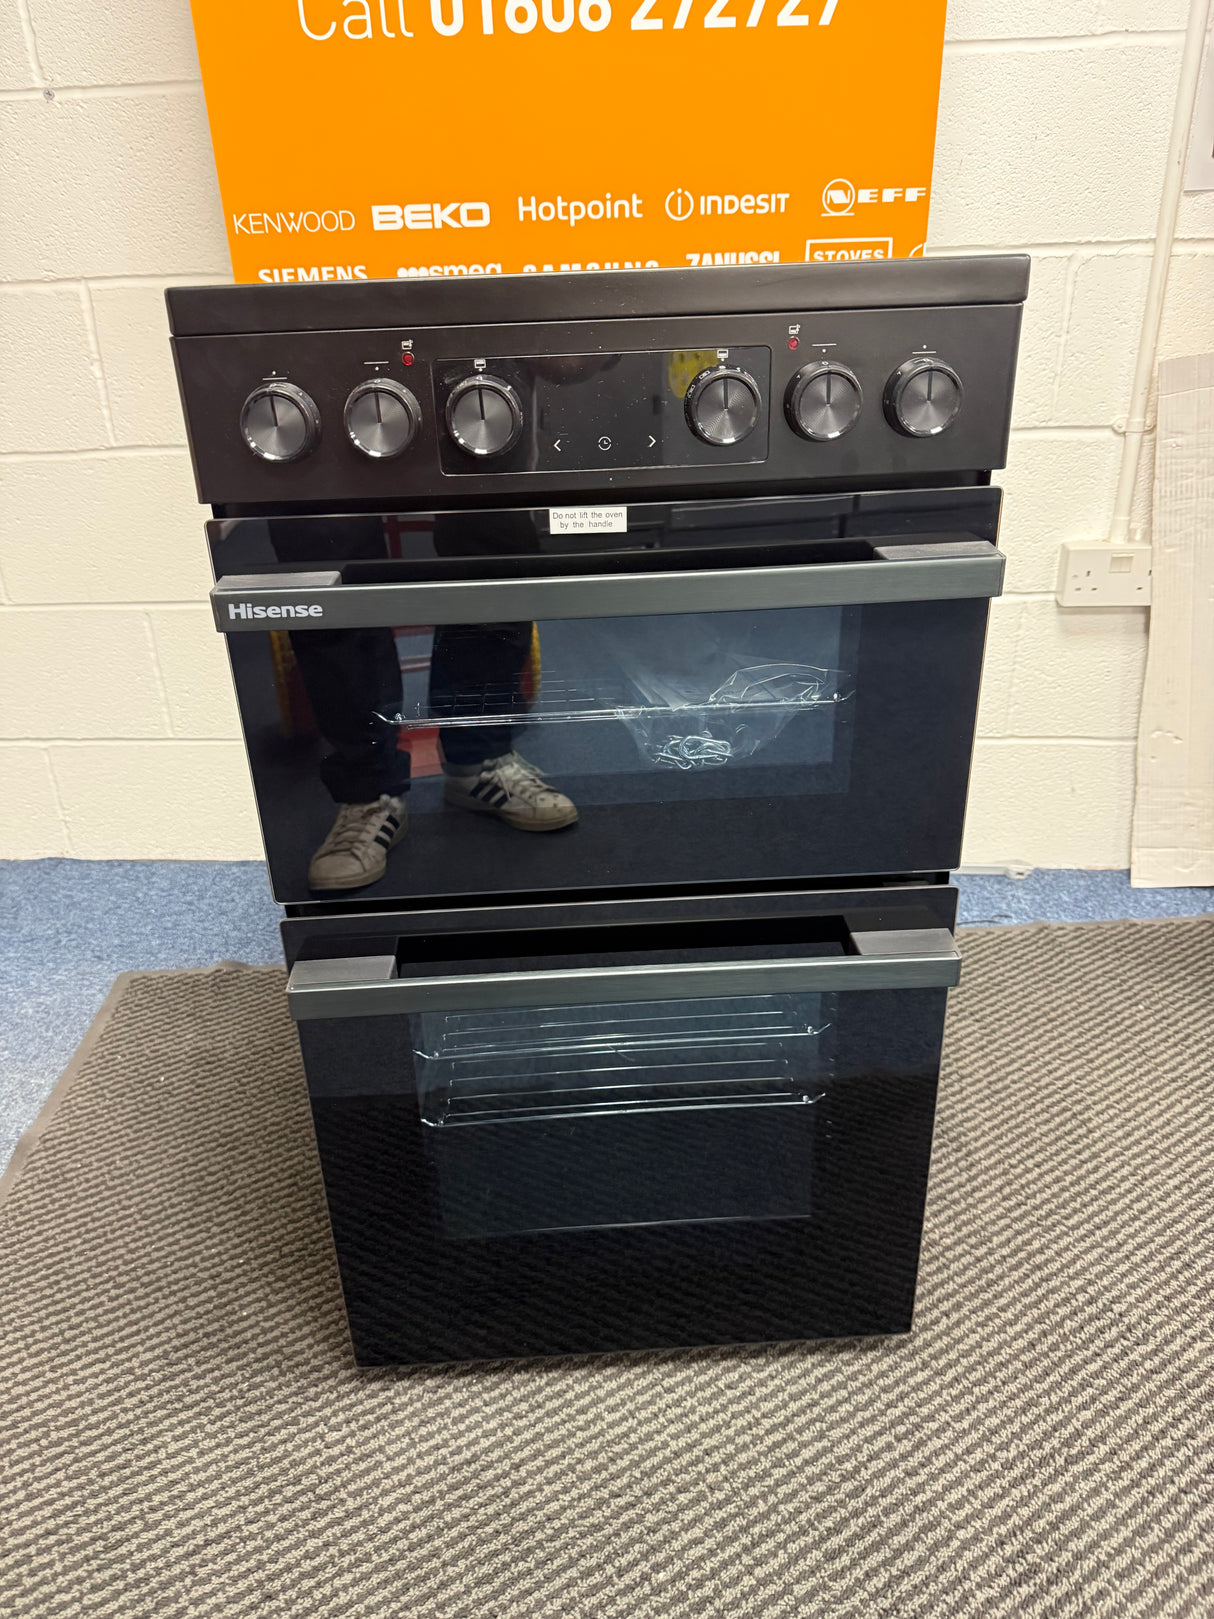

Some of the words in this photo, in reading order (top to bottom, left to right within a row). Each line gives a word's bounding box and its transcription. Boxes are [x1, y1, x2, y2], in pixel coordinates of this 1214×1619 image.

[297, 0, 414, 41] Call
[430, 0, 612, 37] 01606
[371, 201, 491, 231] BEKO
[517, 192, 643, 226] Hotpoint
[233, 210, 356, 235] KENWOOD
[258, 265, 369, 283] SIEMENS
[560, 522, 569, 530] by
[589, 520, 614, 528] handle
[580, 511, 588, 519] lift
[591, 511, 603, 519] the
[228, 603, 323, 620] Hisense
